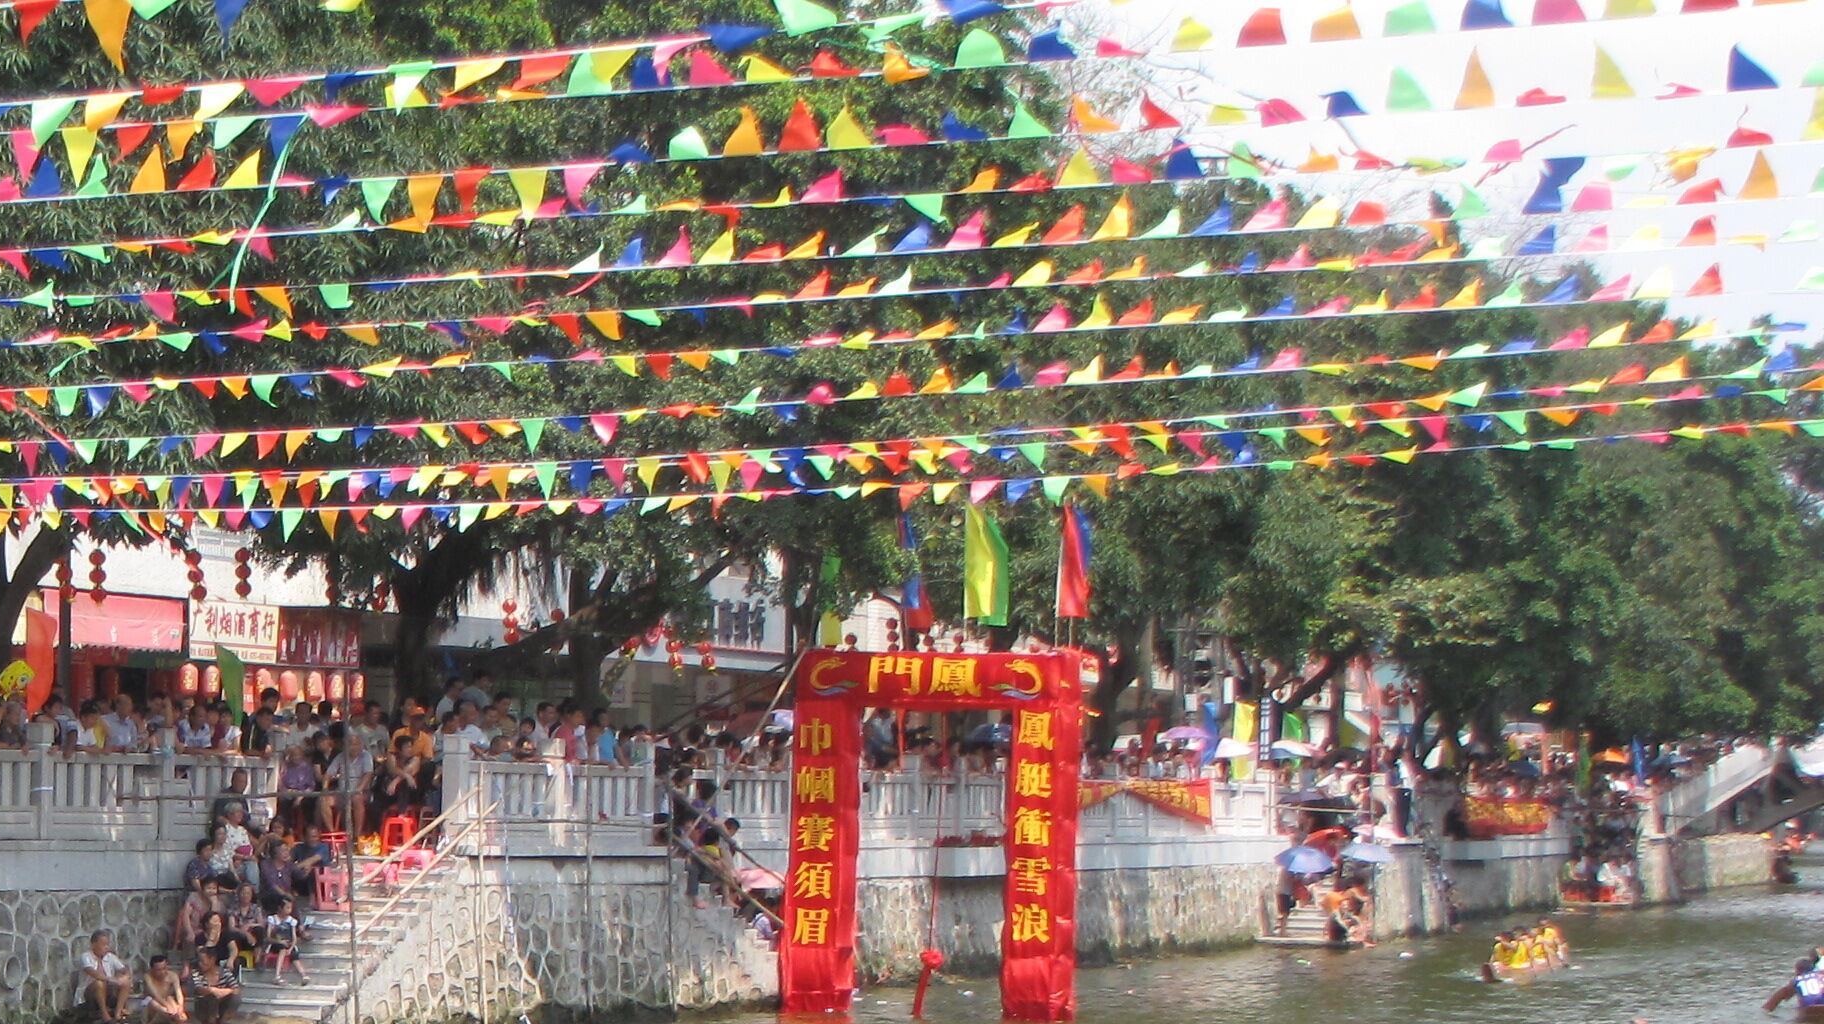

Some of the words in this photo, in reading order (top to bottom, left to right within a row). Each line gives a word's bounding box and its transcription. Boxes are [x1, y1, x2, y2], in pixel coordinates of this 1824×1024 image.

[190, 606, 276, 643] 广利烟酒商行
[792, 717, 836, 946] 巾幗賽須眉
[1011, 709, 1055, 944] 鳳艇衝雪浪
